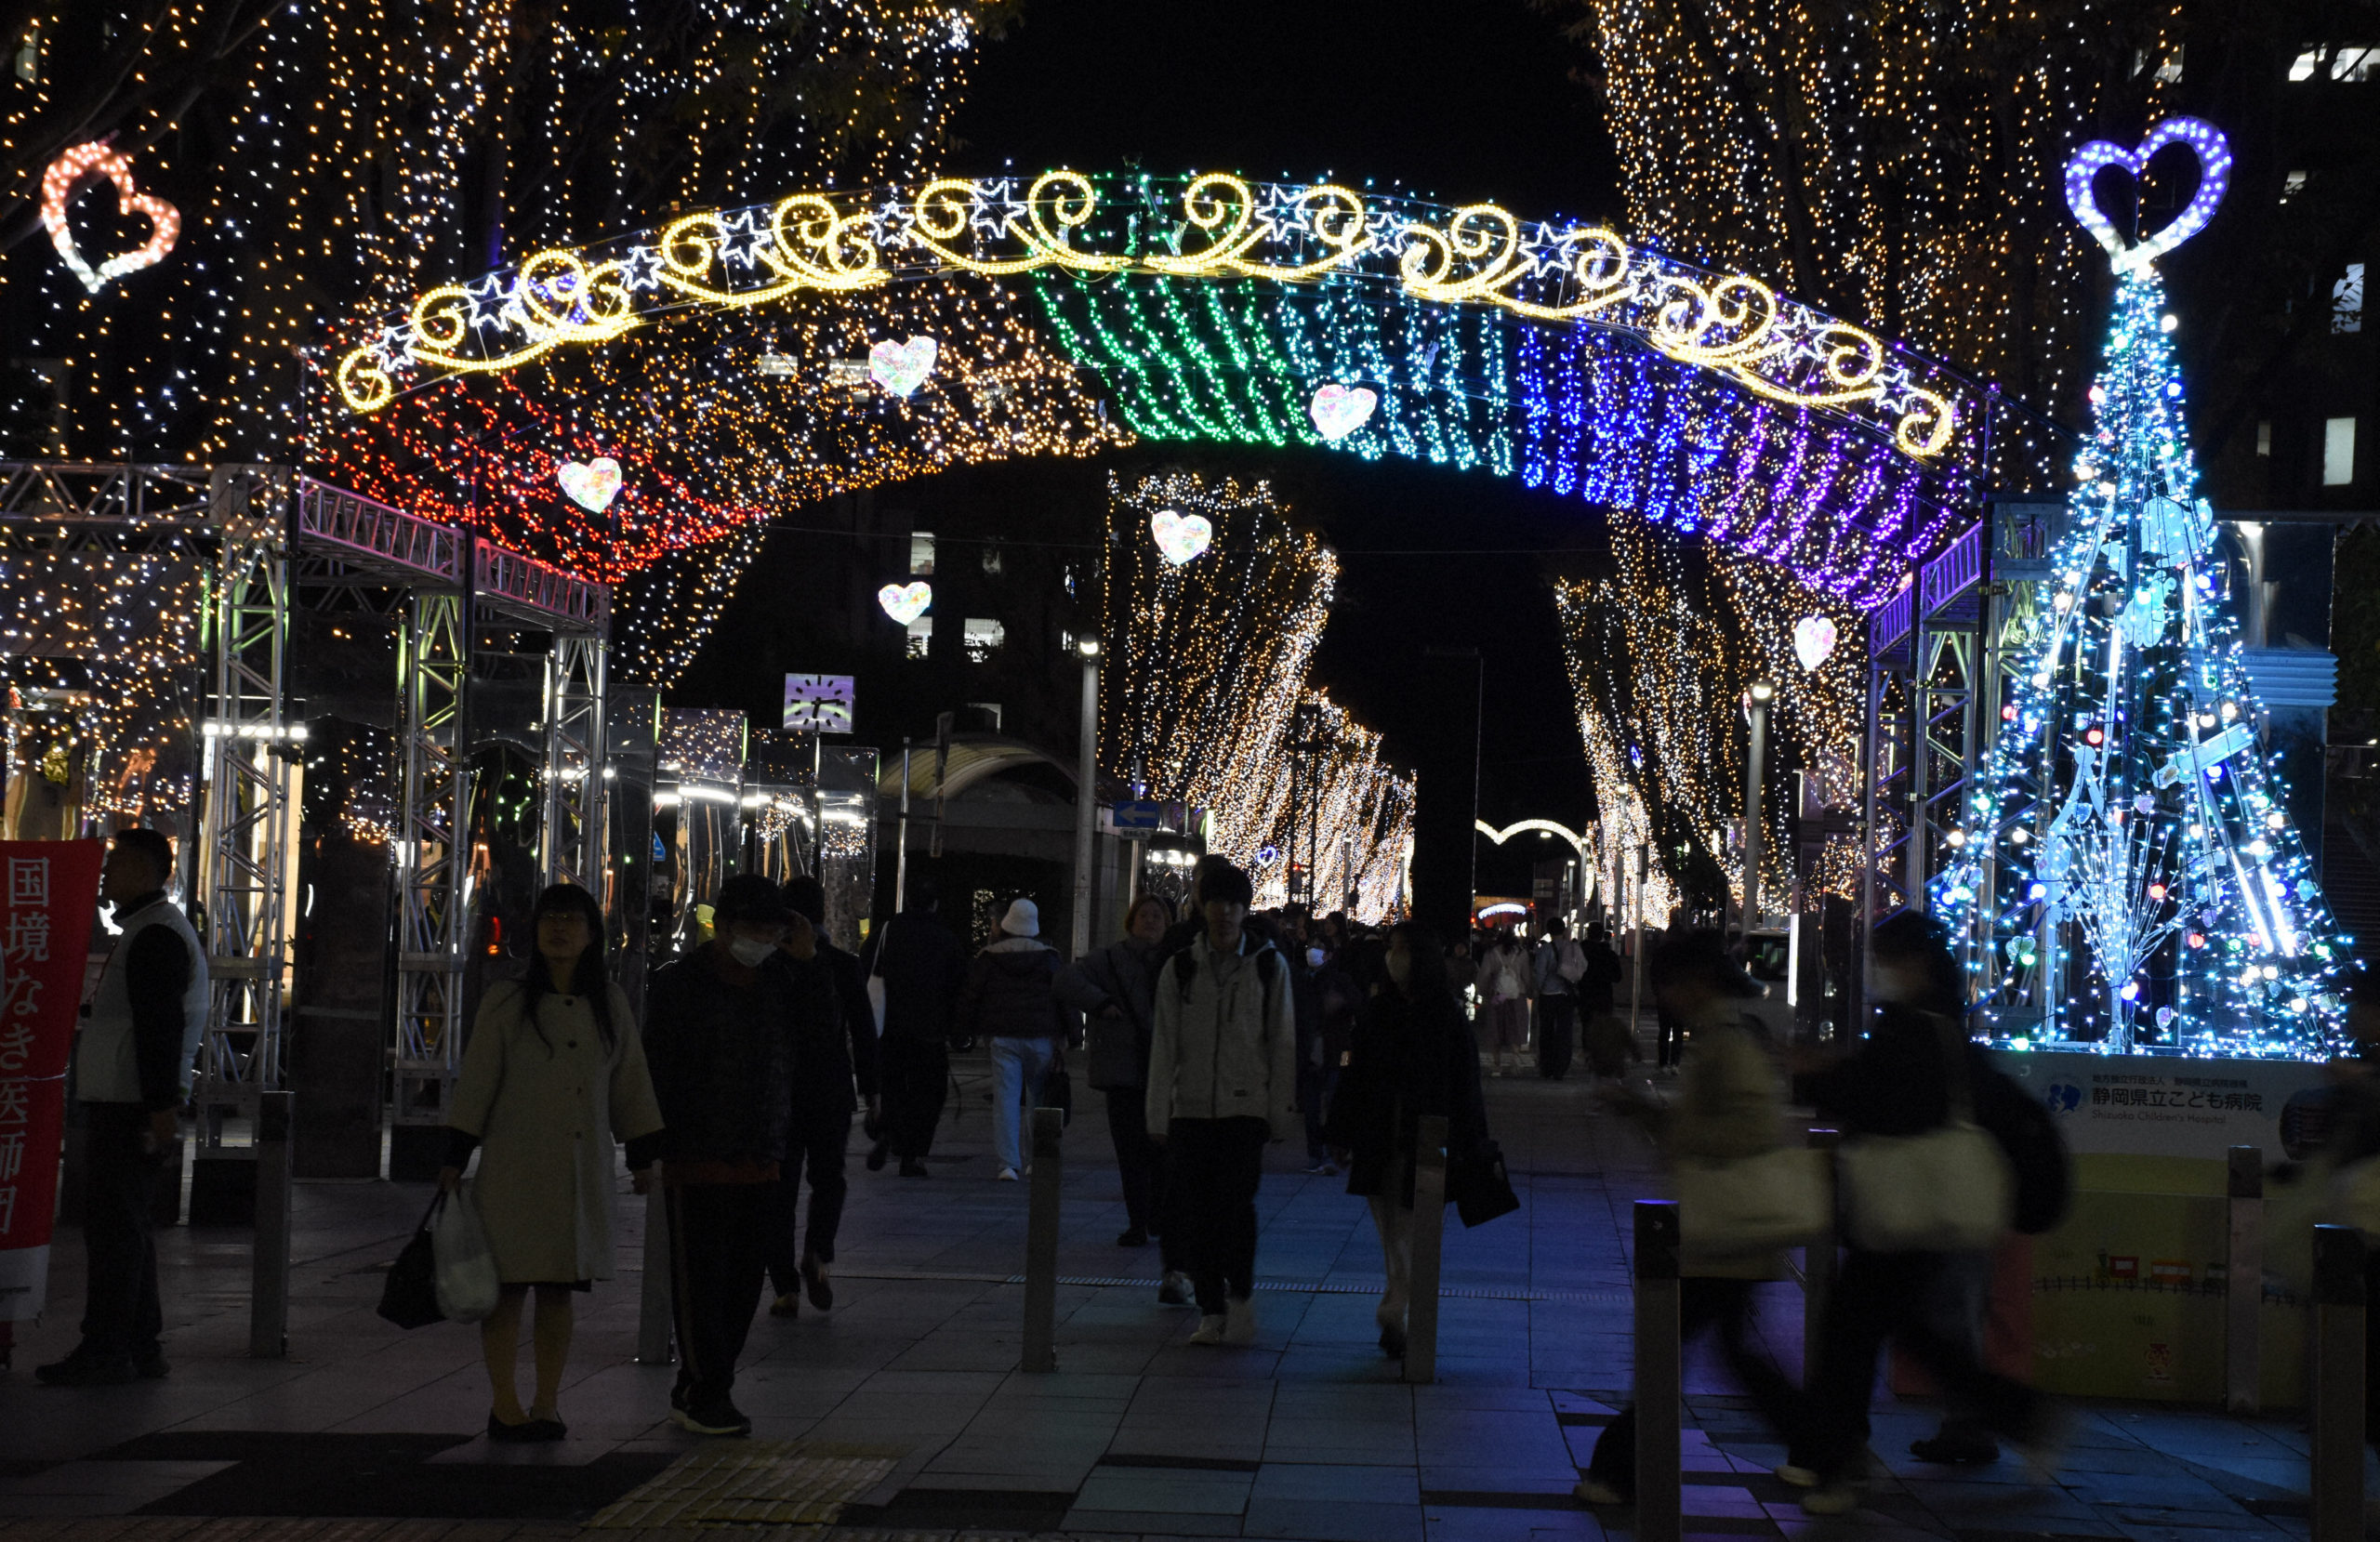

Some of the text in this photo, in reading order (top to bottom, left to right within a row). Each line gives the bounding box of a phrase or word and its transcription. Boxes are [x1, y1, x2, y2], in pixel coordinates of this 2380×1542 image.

[2093, 1087, 2262, 1112] 静岡県立こども病院
[2092, 1109, 2226, 1126] Shizuoka Children's Hospital
